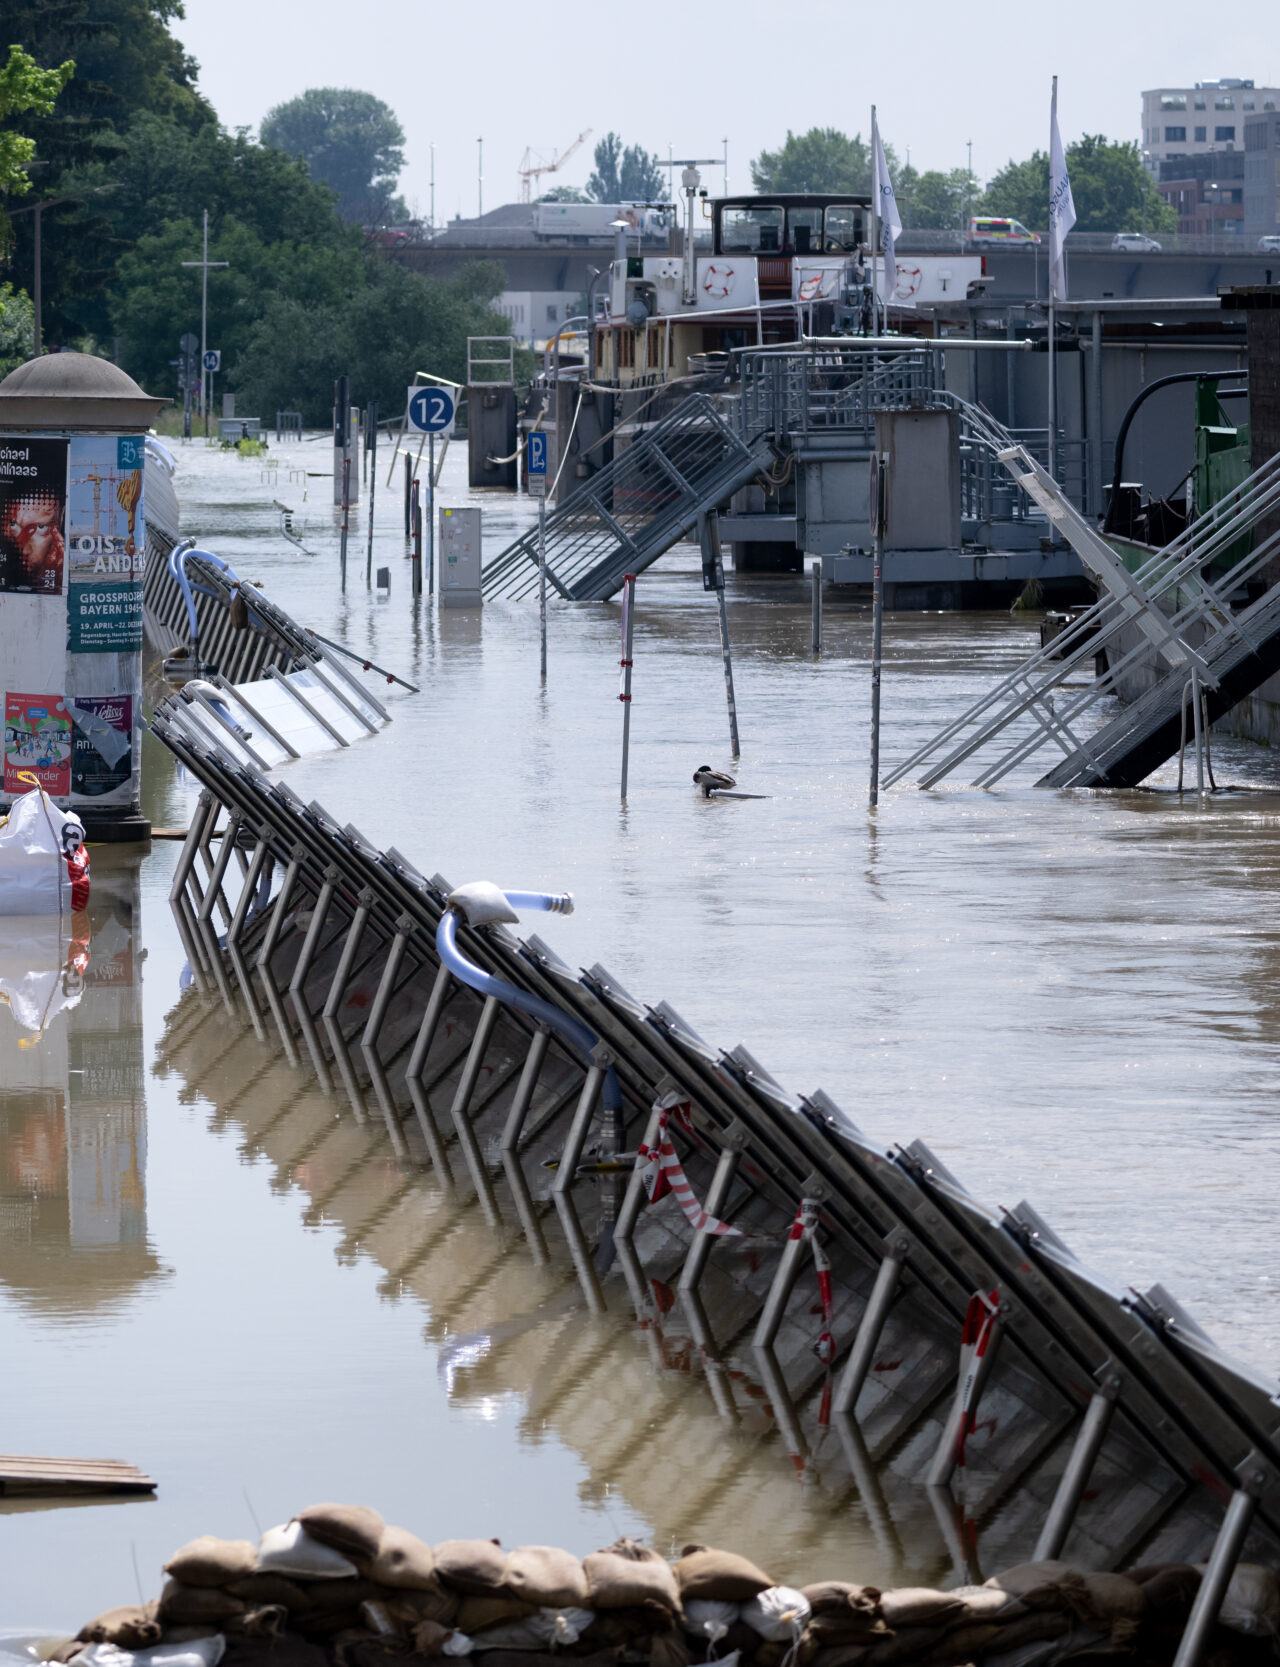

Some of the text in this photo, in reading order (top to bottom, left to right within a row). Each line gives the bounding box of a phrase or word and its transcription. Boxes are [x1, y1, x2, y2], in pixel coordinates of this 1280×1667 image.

[205, 355, 216, 368] 14
[417, 398, 446, 424] 12
[532, 437, 543, 468] P
[78, 535, 115, 554] OIS
[80, 604, 122, 615] BAYERN
